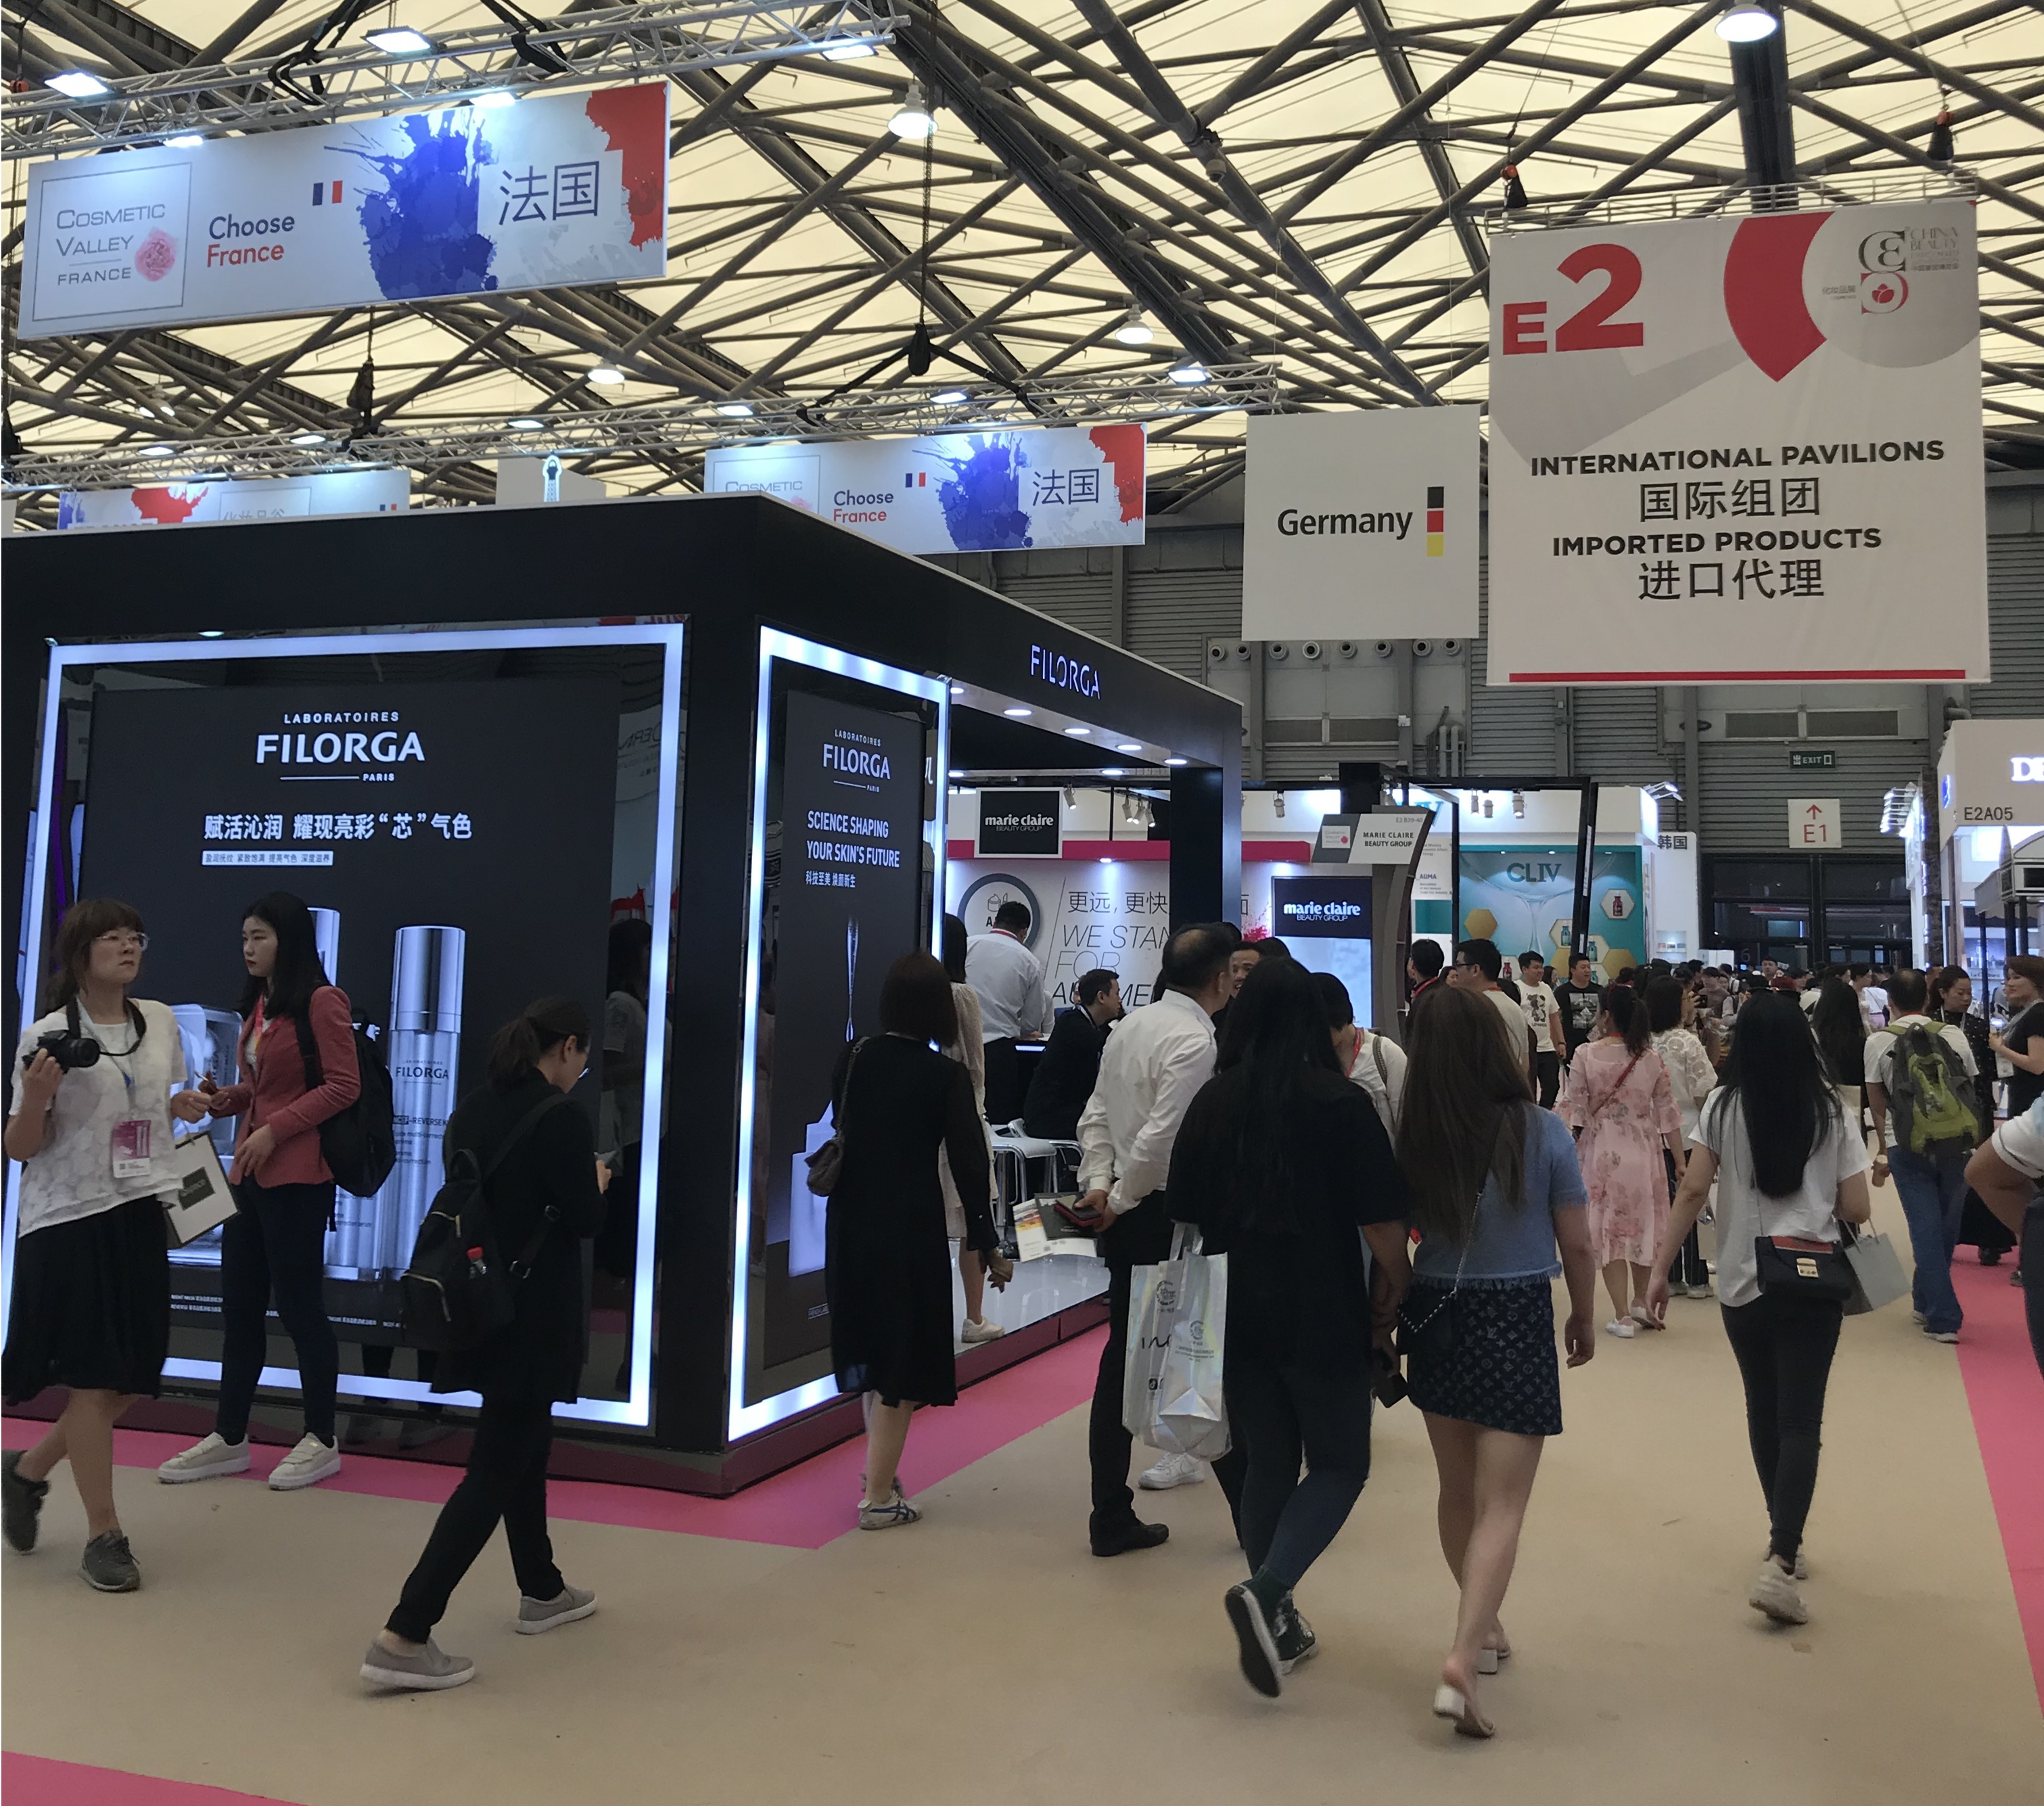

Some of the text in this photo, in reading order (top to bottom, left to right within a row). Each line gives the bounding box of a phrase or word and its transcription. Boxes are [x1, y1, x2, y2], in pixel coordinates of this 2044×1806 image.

[498, 160, 600, 226] 法国
[56, 204, 166, 229] COSMETIC
[209, 214, 295, 239] Choose
[56, 235, 134, 256] VALLEY
[207, 244, 284, 268] France
[57, 267, 132, 285] FRANCE
[1502, 243, 1644, 355] E2
[1531, 440, 1945, 476] INTERNATIONAL PAVILIONS
[834, 490, 894, 506] Choose
[1032, 468, 1100, 507] 法国
[1640, 476, 1821, 522] 国际组团
[833, 509, 887, 523] France
[1278, 509, 1414, 540] Germany
[1553, 528, 1882, 557] IMPORTED PRODUCTS
[1638, 558, 1826, 600] 进口代理
[1031, 645, 1100, 700] FILORGA
[284, 712, 400, 724] LABORATOIRES
[256, 731, 425, 764] FILORGA
[835, 729, 881, 747] LABORATOIRES
[822, 743, 891, 780] FILORGA
[363, 773, 395, 782] PARIS
[808, 810, 889, 838] SCIENCE SHAPING
[985, 814, 1054, 826] marie claire
[1964, 807, 2014, 820] E2A05
[204, 814, 283, 841] 赋活沁润
[1803, 824, 1827, 843] E1
[806, 840, 900, 868] YOUR SKIN'S FUTURE
[1657, 835, 1688, 850] 韩国
[1507, 862, 1562, 883] CLIV
[1284, 901, 1361, 916] marie claire
[1063, 925, 1104, 948] WE
[1054, 950, 1120, 979] FOR
[395, 1067, 450, 1080] FILORGA
